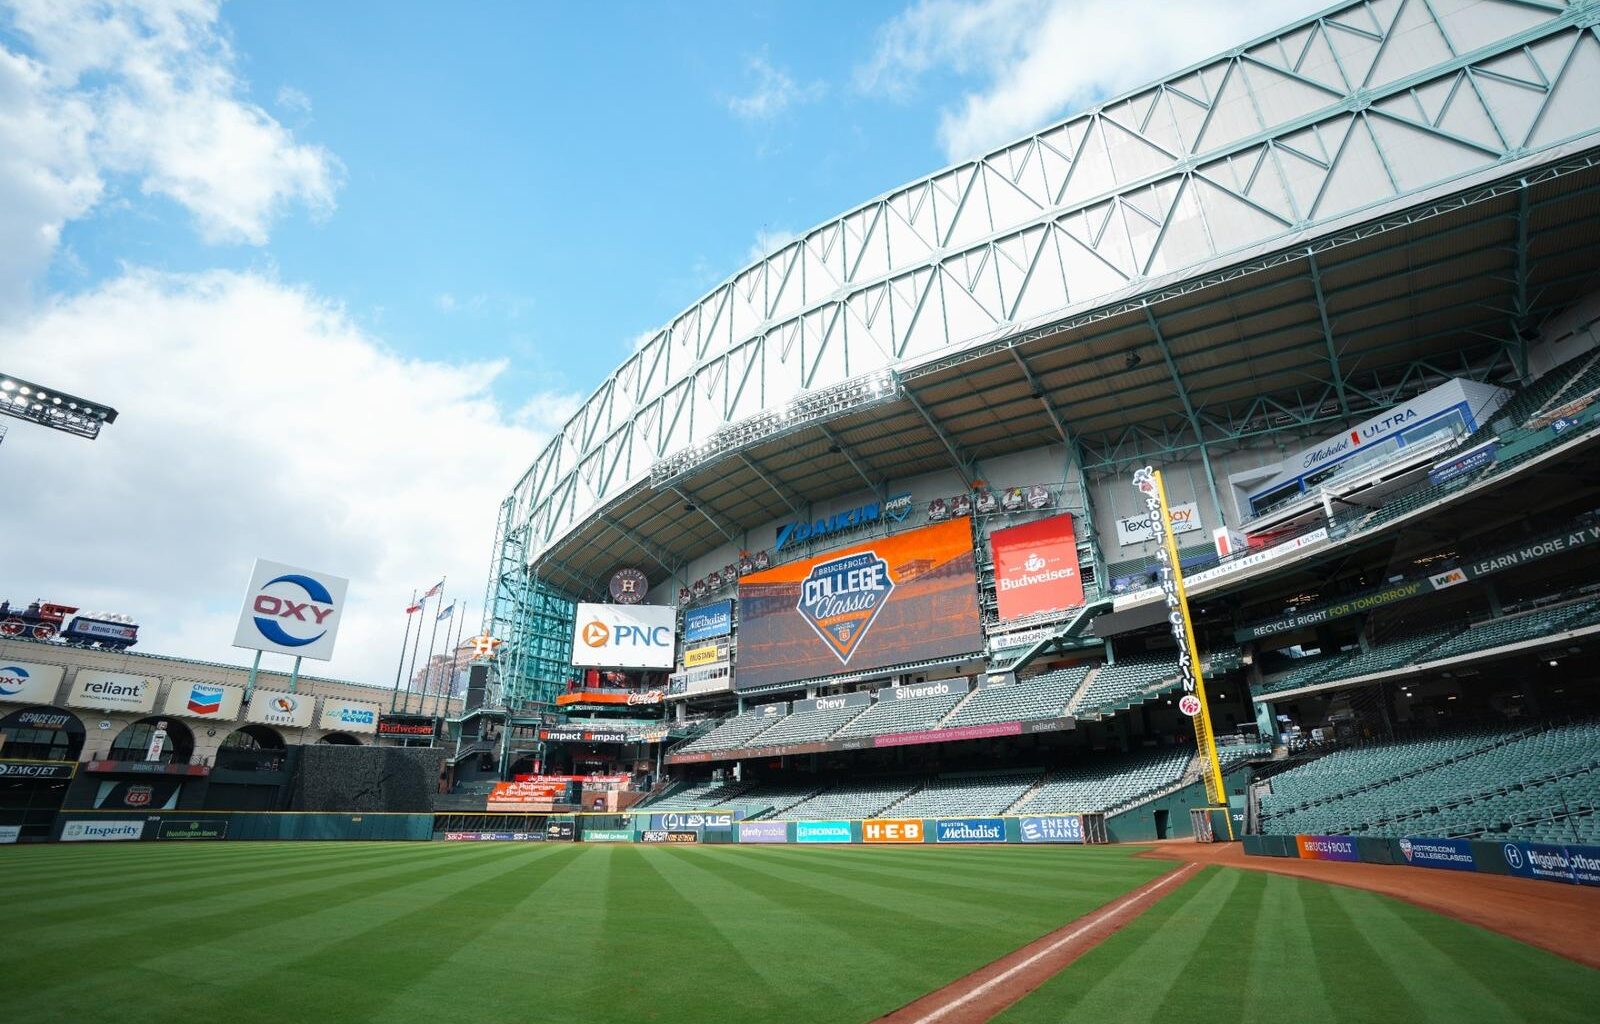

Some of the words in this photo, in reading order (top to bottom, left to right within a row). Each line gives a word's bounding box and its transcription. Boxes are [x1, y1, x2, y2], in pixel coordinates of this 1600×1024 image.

[1554, 420, 1566, 430] 80
[1303, 437, 1349, 468] Michelob
[1363, 409, 1417, 438] ULTRA
[1462, 451, 1488, 466] ULTRA
[886, 495, 912, 511] PARK
[795, 502, 880, 540] DAIKIN
[1146, 498, 1166, 544] ROOT
[1302, 531, 1326, 544] ULTRA
[1473, 553, 1518, 576] LEARN
[1520, 538, 1565, 561] MORE
[1568, 531, 1586, 546] AT
[818, 562, 844, 576] BRUCE
[848, 556, 868, 569] BOLT
[622, 579, 636, 592] H
[805, 563, 885, 607] COLLEGE
[1000, 567, 1075, 592] Budweiser
[1435, 572, 1462, 586] WM
[1160, 567, 1178, 607] THA
[253, 594, 334, 624] OXY
[815, 591, 876, 619] Classic
[689, 612, 727, 630] Methodist
[1253, 618, 1296, 636] RECYCLE
[1297, 610, 1328, 626] RIGHT
[1328, 604, 1349, 617] FOR
[91, 624, 111, 634] BRING
[612, 625, 670, 647] PNC
[474, 636, 496, 655] H
[1170, 612, 1195, 692] CHIKIN
[689, 650, 715, 662] MUSTANG
[0, 676, 26, 685] XY
[193, 683, 225, 693] Chevron
[84, 681, 140, 697] reliant
[895, 683, 949, 699] Silverado
[816, 698, 846, 709] Chevy
[19, 712, 49, 722] SPACE
[49, 714, 71, 724] CITY
[380, 722, 433, 734] Budweiser
[1031, 721, 1057, 732] reliant
[547, 732, 581, 741] impact
[591, 732, 625, 742] impact
[129, 793, 147, 802] 66
[84, 825, 138, 836] Insperity
[763, 827, 785, 836] mobile
[808, 827, 849, 836] HONDA
[942, 824, 1001, 839] Methodist
[1303, 841, 1328, 852] BRUCE
[1332, 842, 1352, 853] BOLT
